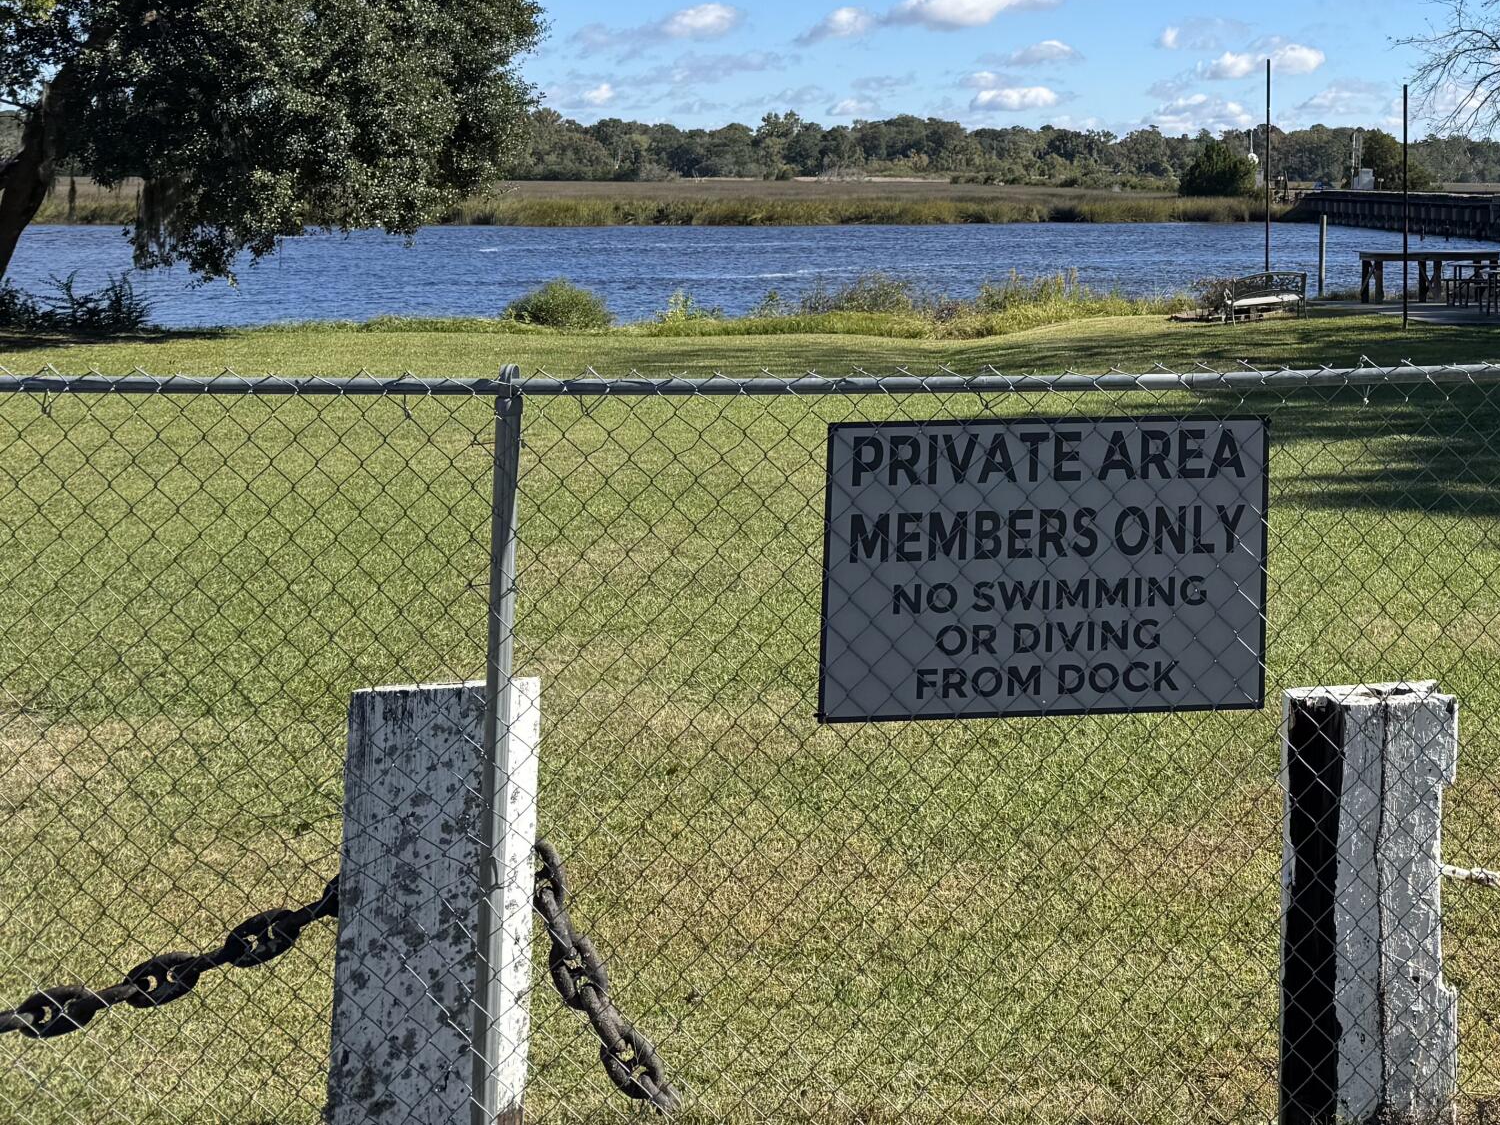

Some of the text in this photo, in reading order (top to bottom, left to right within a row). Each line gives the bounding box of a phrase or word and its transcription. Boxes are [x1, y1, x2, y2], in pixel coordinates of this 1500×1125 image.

[851, 428, 1246, 487] PRIVATE AREA
[849, 503, 1246, 564] MEMBERS ONLY
[892, 575, 1208, 615] NO SWIMMING
[936, 619, 1161, 656] OR DIVING
[916, 661, 1180, 700] FROM DOCK
